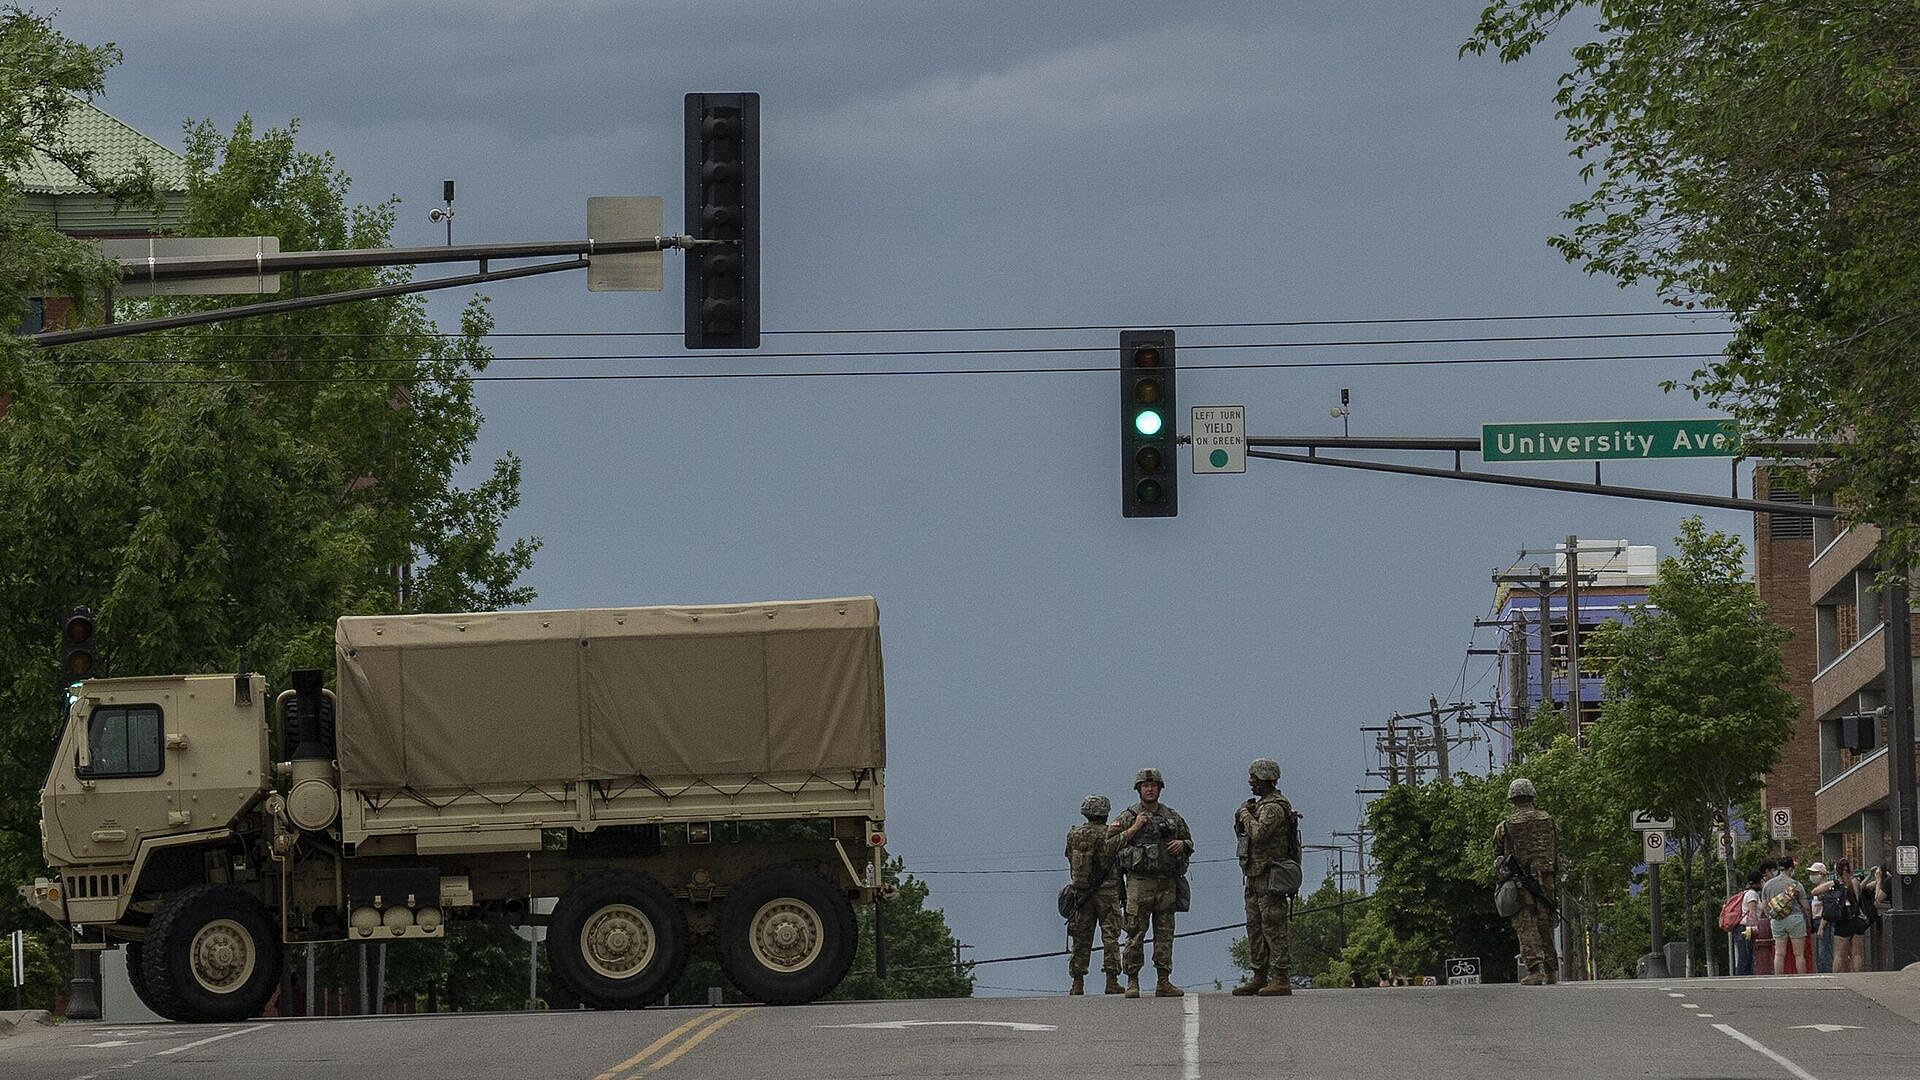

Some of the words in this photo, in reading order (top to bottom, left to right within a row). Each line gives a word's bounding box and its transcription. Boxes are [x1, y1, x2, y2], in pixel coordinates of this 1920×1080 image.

[1195, 411, 1214, 420] LEFT
[1220, 411, 1241, 420] TURN
[1204, 423, 1233, 433] YIELD
[1196, 437, 1208, 445] ON
[1212, 436, 1241, 445] GREEN
[1497, 430, 1655, 457] University
[1672, 429, 1726, 450] Ave
